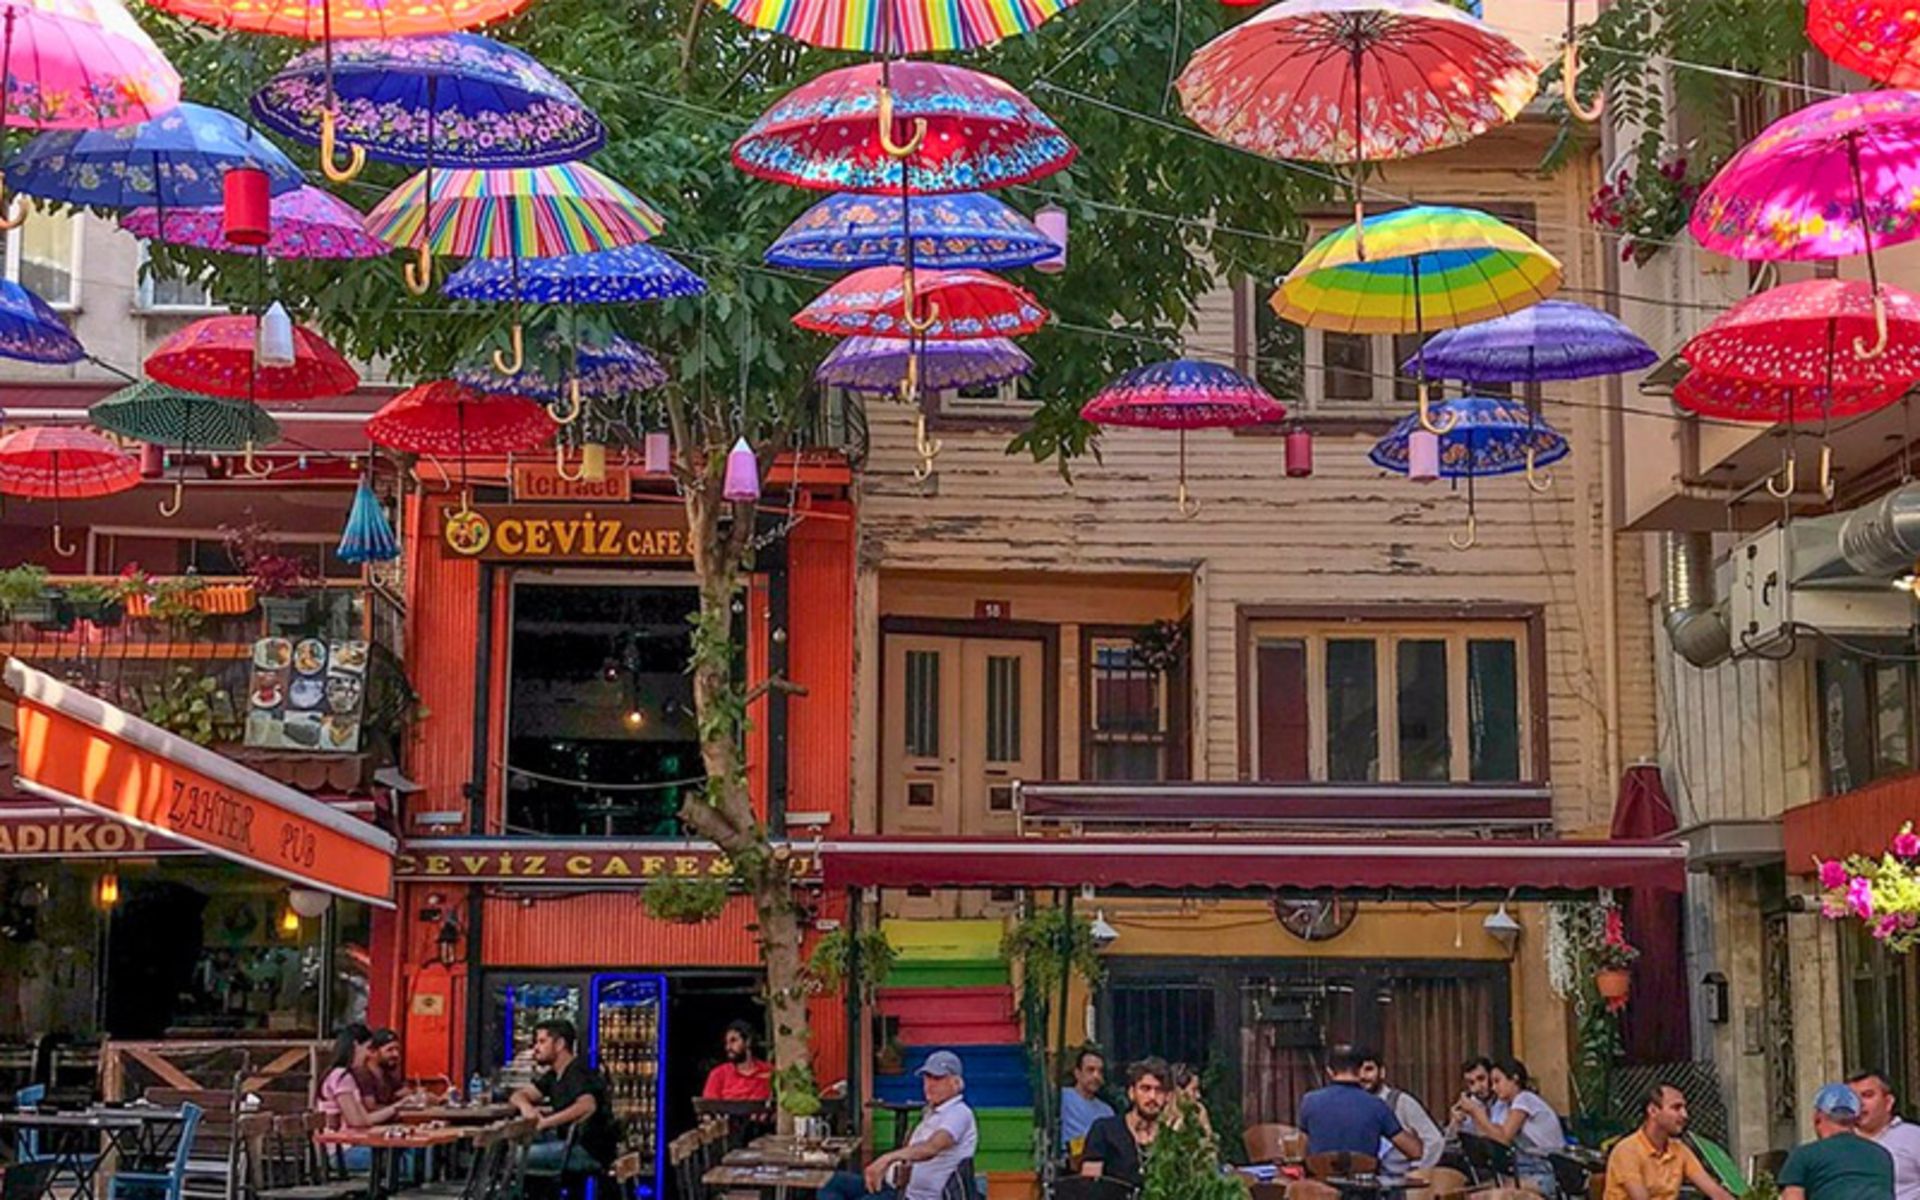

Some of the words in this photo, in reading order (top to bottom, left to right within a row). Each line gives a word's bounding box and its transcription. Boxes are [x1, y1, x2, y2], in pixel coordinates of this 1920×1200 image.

[496, 511, 621, 554] CEVİZ
[627, 530, 681, 555] CAFE
[167, 779, 255, 853] ZAHTER
[280, 821, 316, 868] PUB
